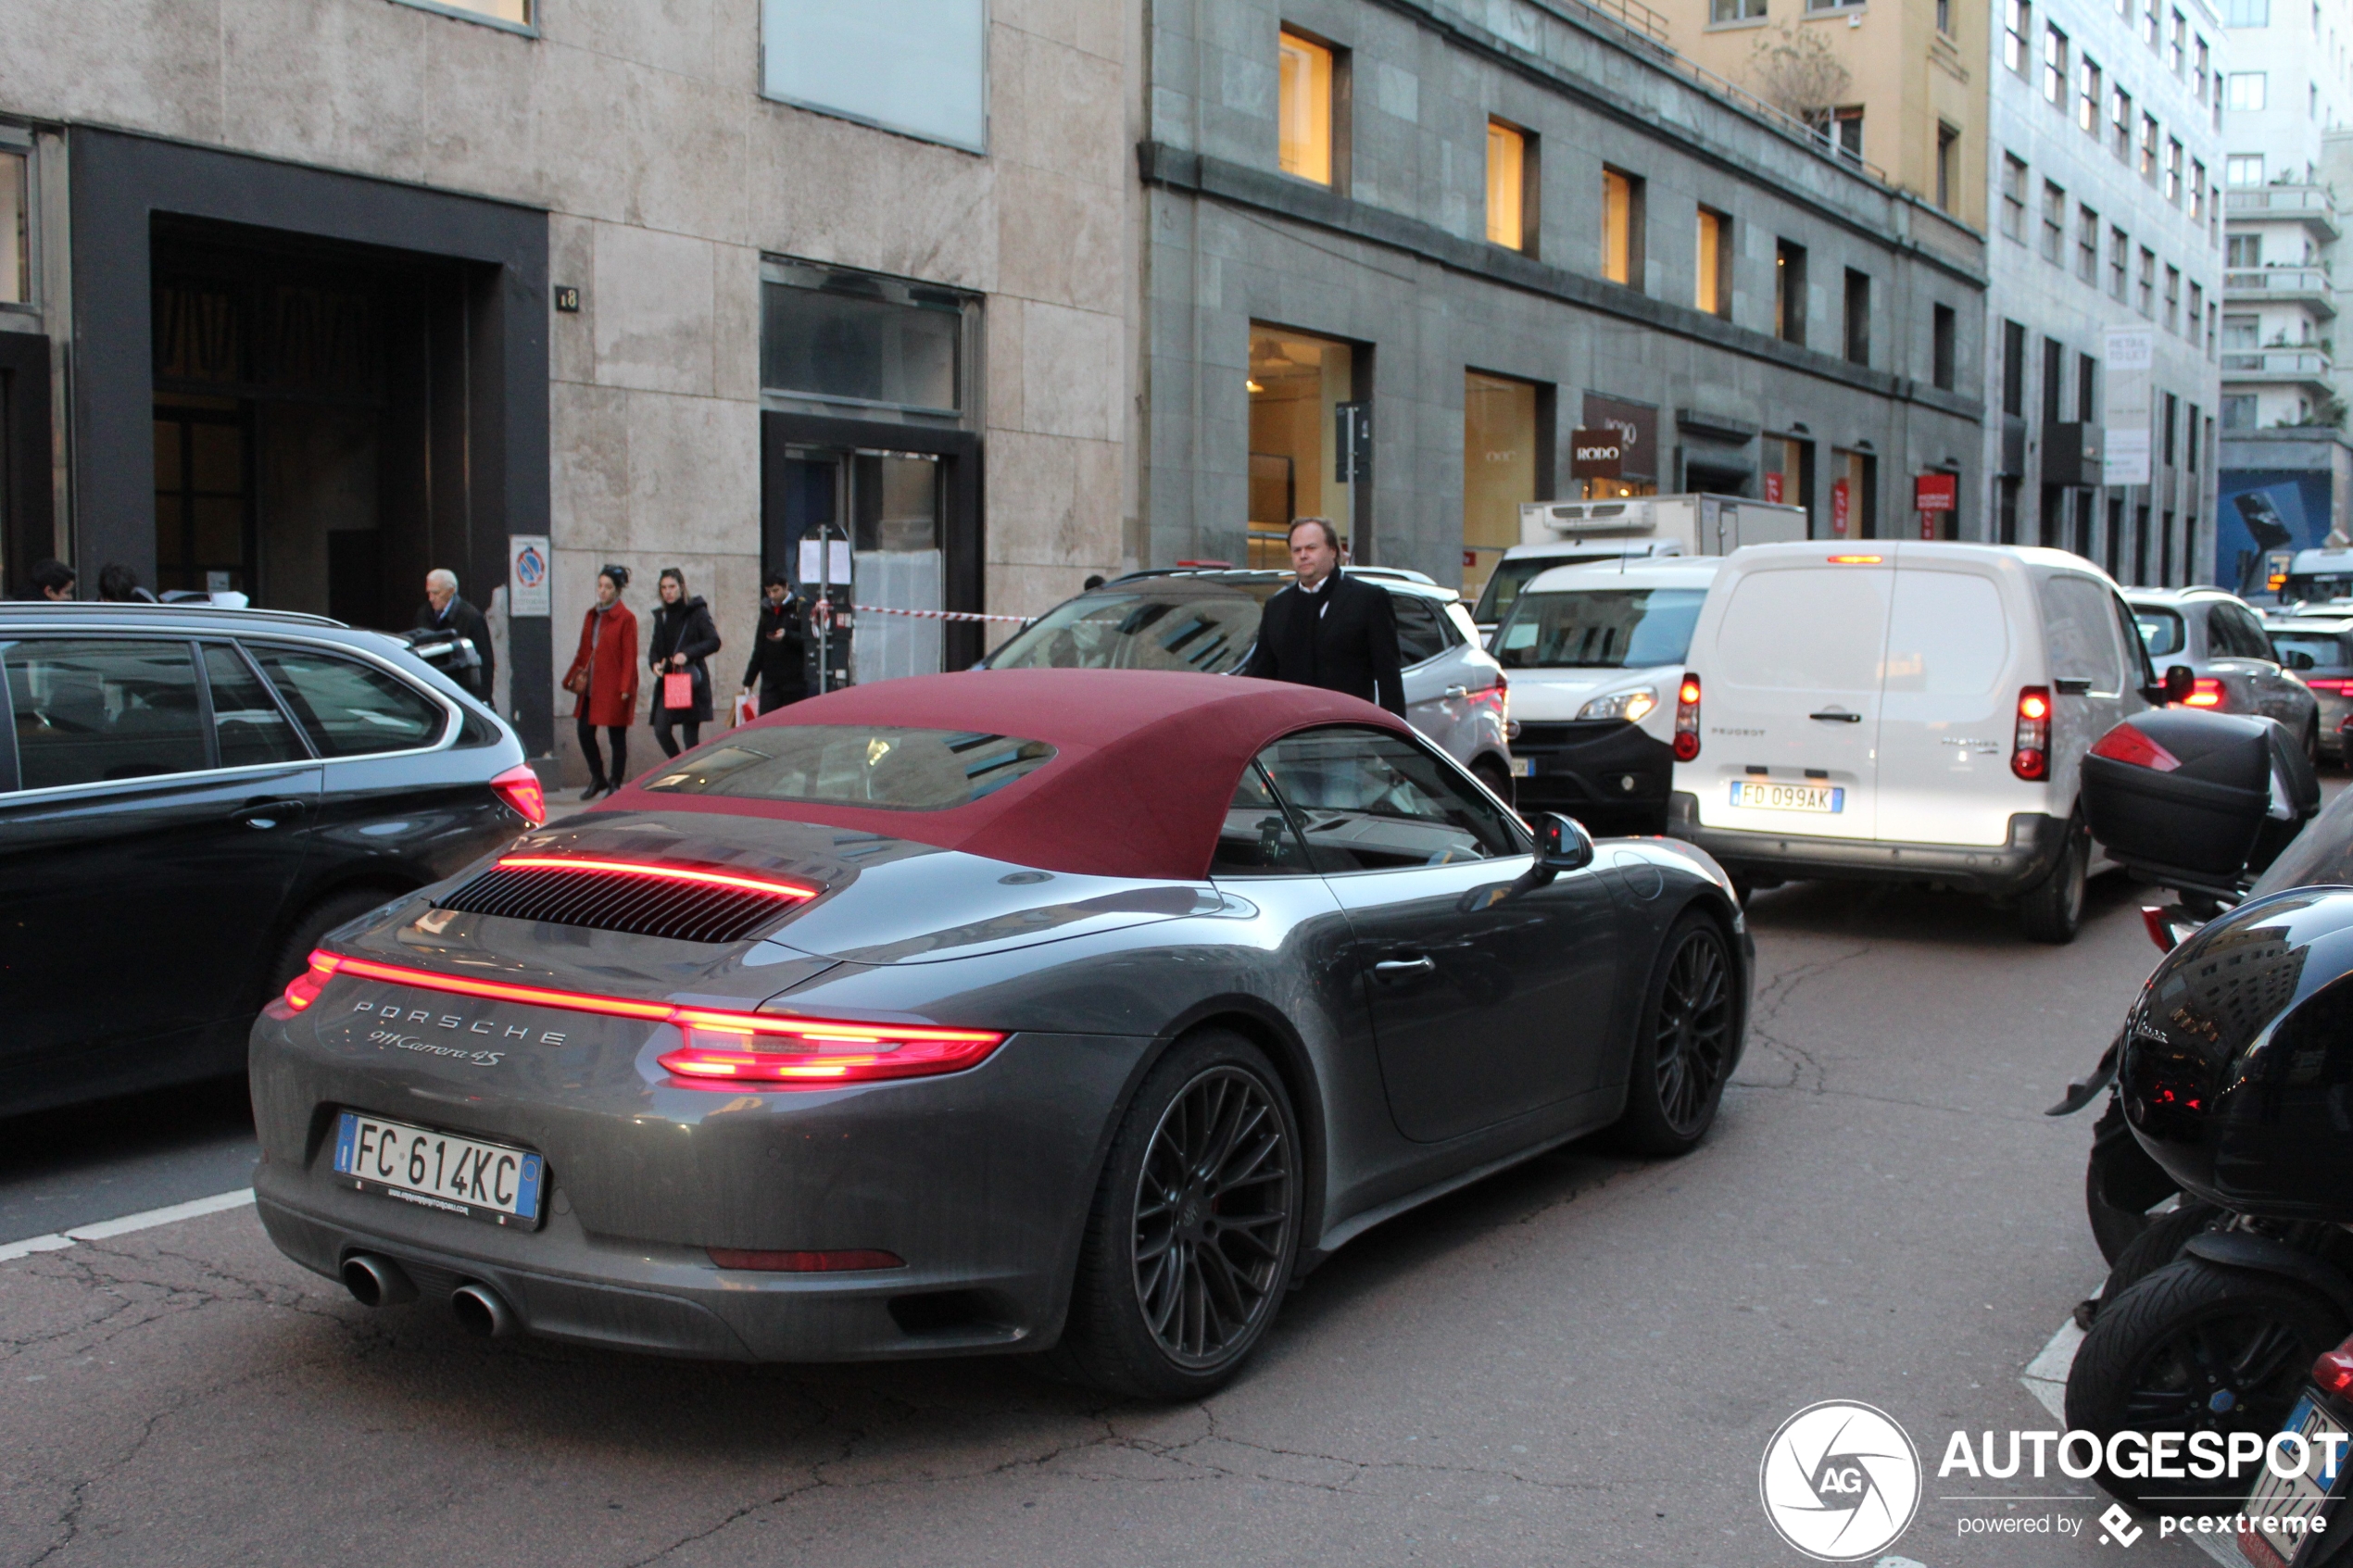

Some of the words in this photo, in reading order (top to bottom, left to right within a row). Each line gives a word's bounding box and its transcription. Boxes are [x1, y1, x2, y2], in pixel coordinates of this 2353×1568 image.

[560, 289, 576, 307] 18
[1576, 445, 1620, 461] RODO
[1711, 727, 1767, 736] PEUGEOT
[1743, 784, 1765, 806] FD
[1772, 787, 1830, 810] 099AK
[353, 1001, 567, 1047] PORSCHE
[368, 1030, 401, 1045] 911
[396, 1035, 469, 1060] Carrera
[470, 1049, 506, 1067] 4S
[356, 1123, 397, 1177] FC
[408, 1135, 516, 1206] 614KC
